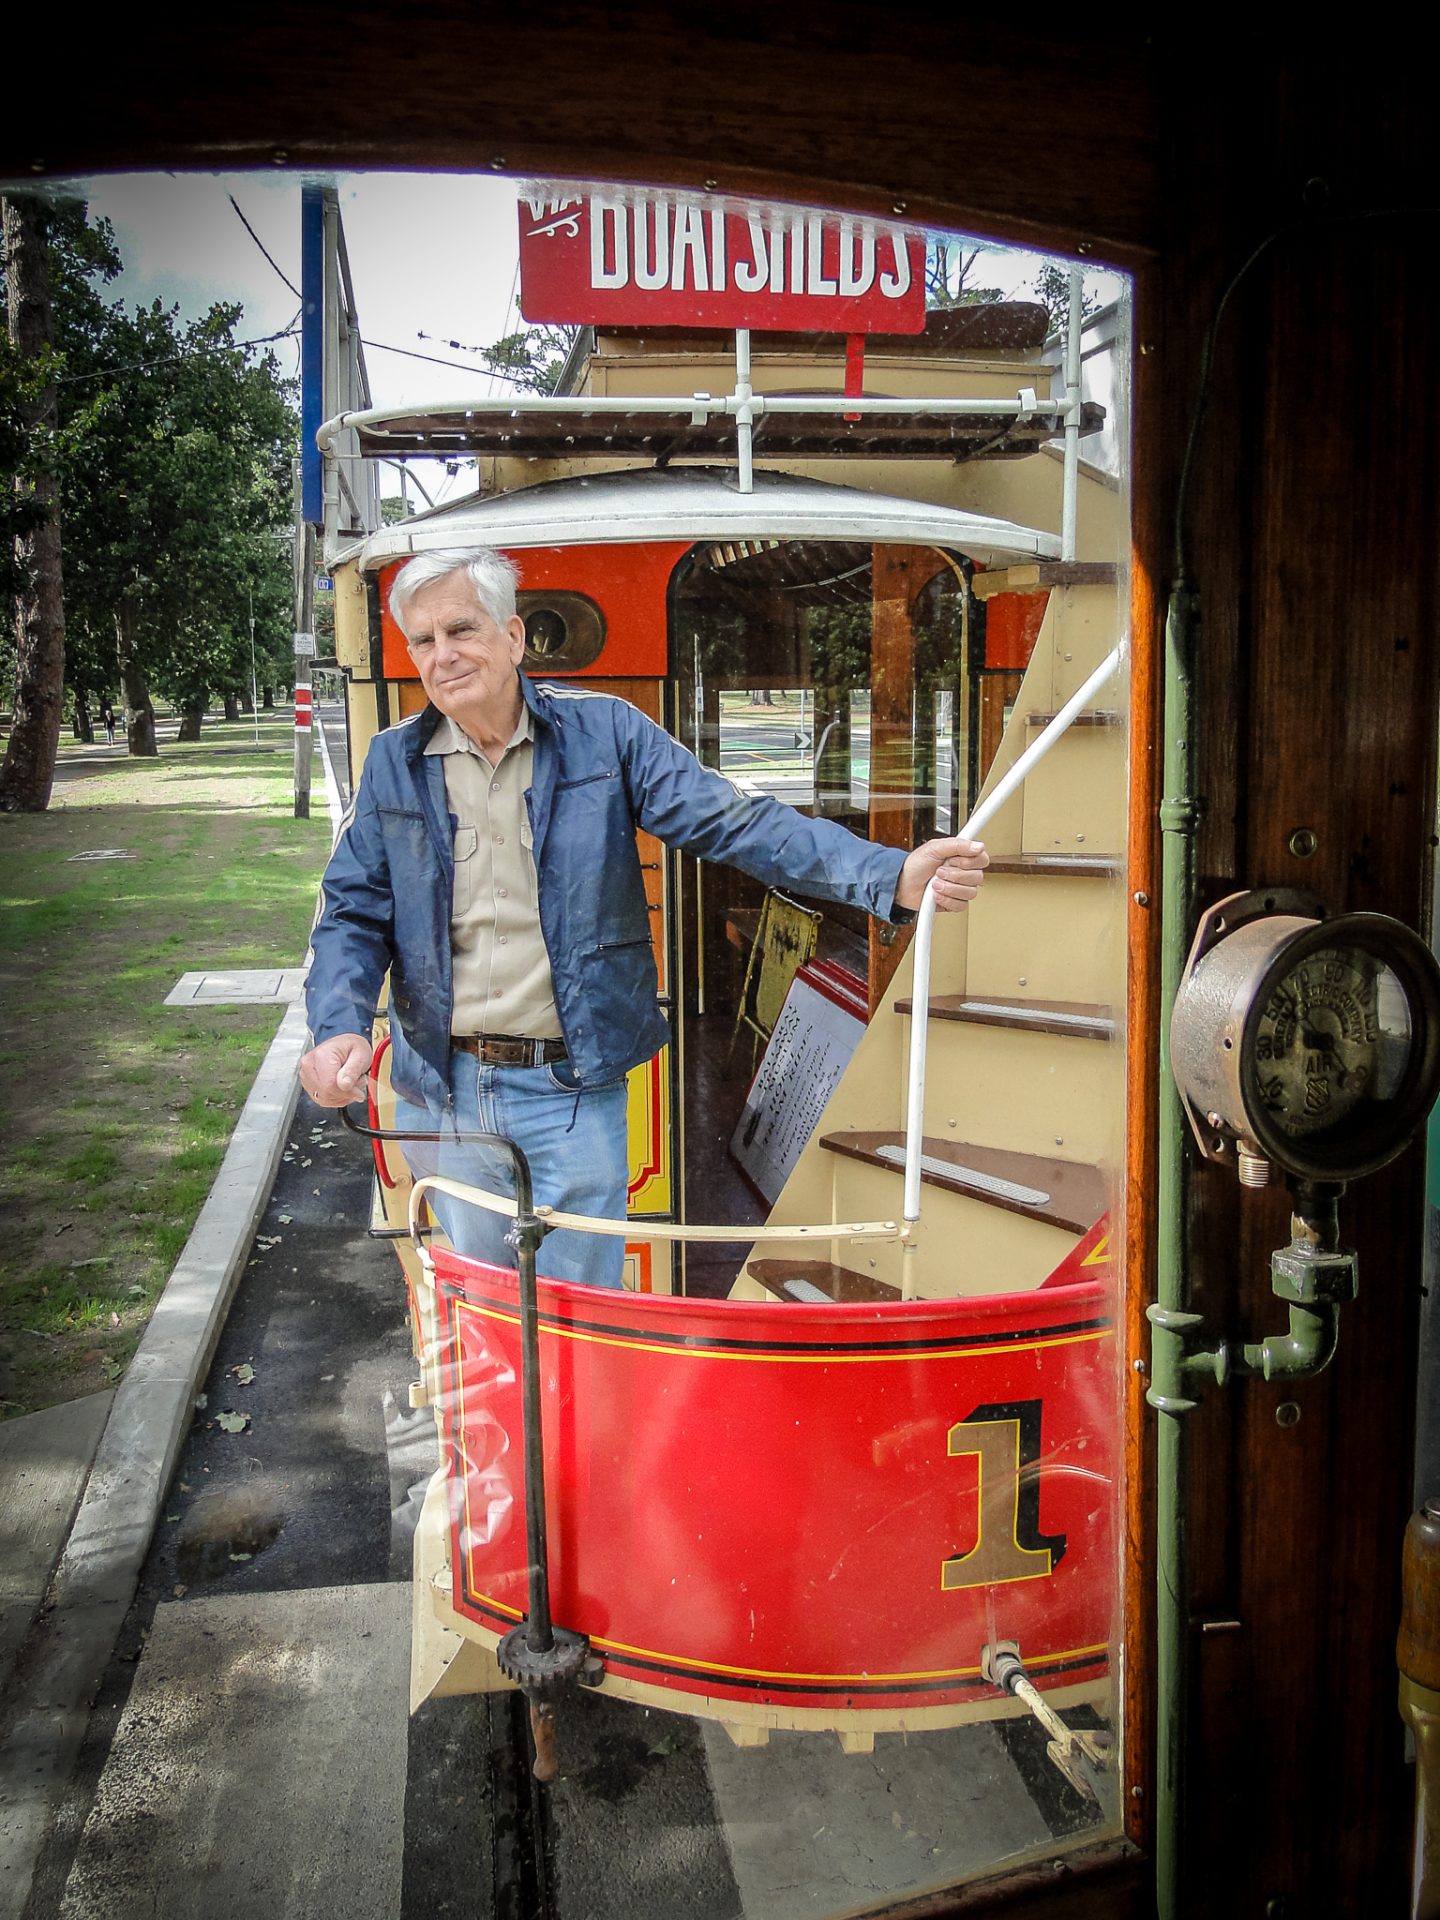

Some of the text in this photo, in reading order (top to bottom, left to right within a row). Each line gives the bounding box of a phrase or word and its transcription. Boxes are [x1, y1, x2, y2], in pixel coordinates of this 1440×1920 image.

[1257, 1036, 1273, 1060] 30
[1305, 1053, 1334, 1075] AIR
[941, 1417, 1054, 1591] 1
